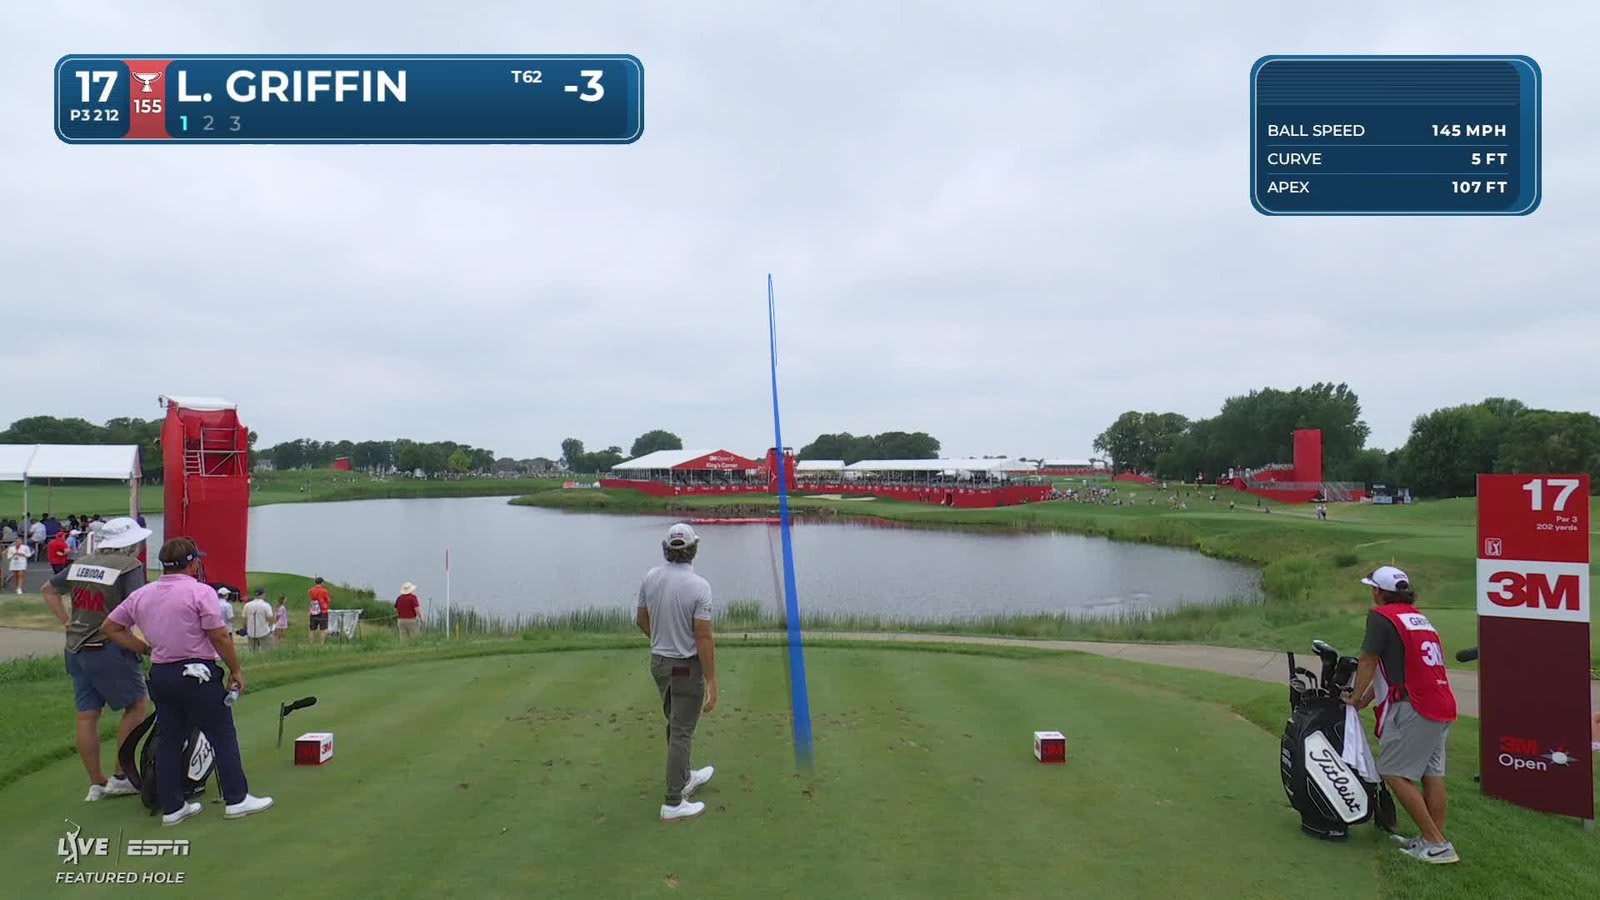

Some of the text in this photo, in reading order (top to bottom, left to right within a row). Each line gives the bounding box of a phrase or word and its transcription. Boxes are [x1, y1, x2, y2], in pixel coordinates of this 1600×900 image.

[1522, 478, 1580, 511] 17
[1536, 523, 1554, 531] 202
[1556, 515, 1570, 523] Par
[76, 567, 106, 580] LEBODA
[1486, 571, 1580, 611] 3M
[1500, 735, 1538, 754] 3M
[1498, 753, 1547, 771] Open
[1309, 749, 1361, 814] Titleist
